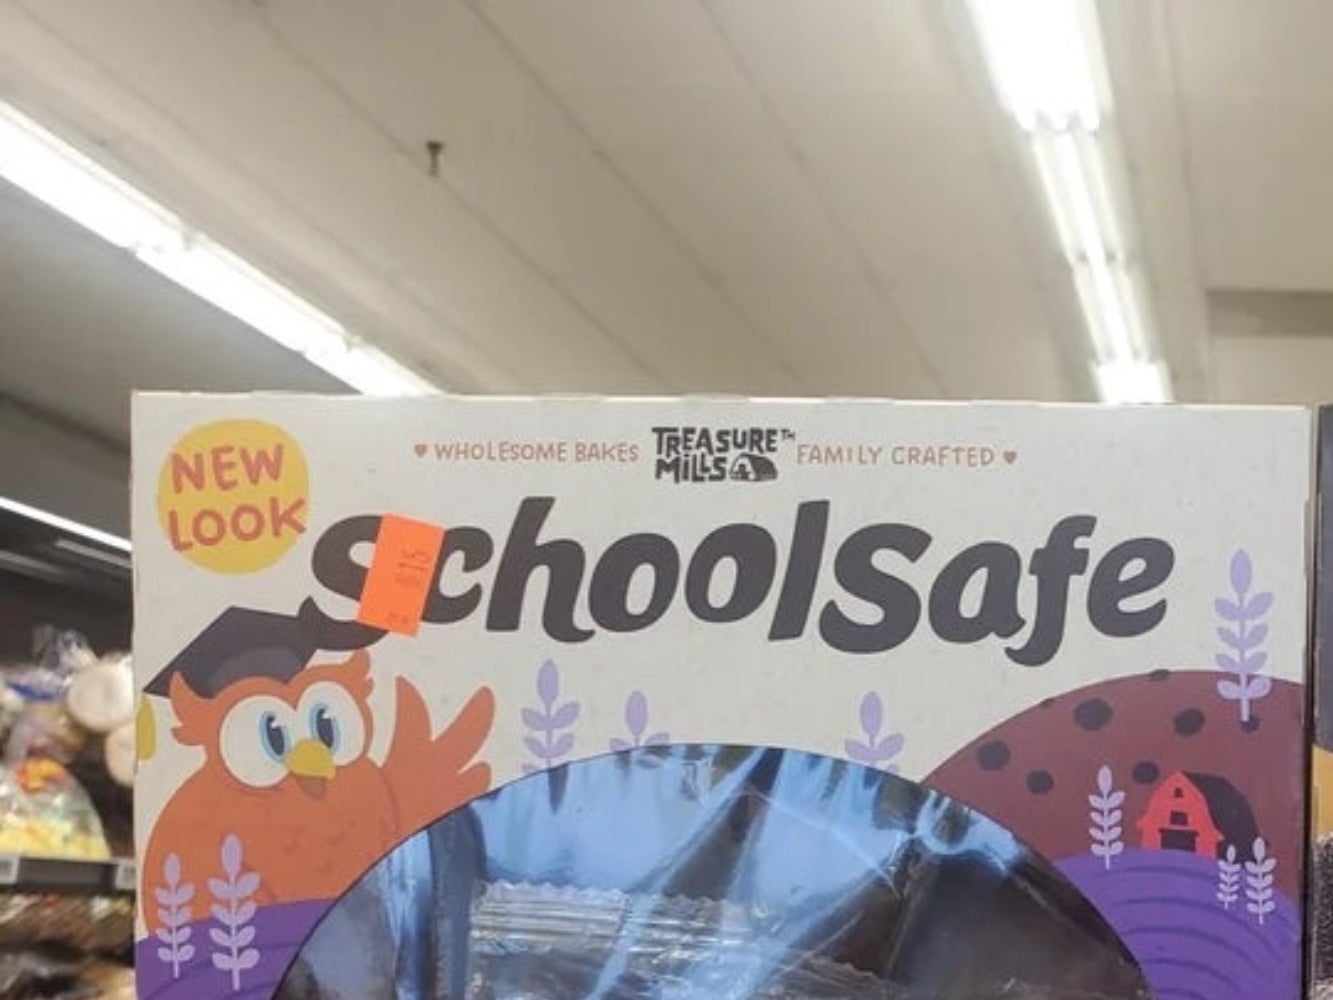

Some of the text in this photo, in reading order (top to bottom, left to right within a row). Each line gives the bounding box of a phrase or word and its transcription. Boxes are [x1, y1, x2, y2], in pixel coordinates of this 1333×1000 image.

[169, 442, 285, 495] NEW
[434, 441, 639, 463] WHOLESOME BAKES
[797, 443, 995, 467] FAMILY CRAFTED
[168, 497, 307, 552] LOOK
